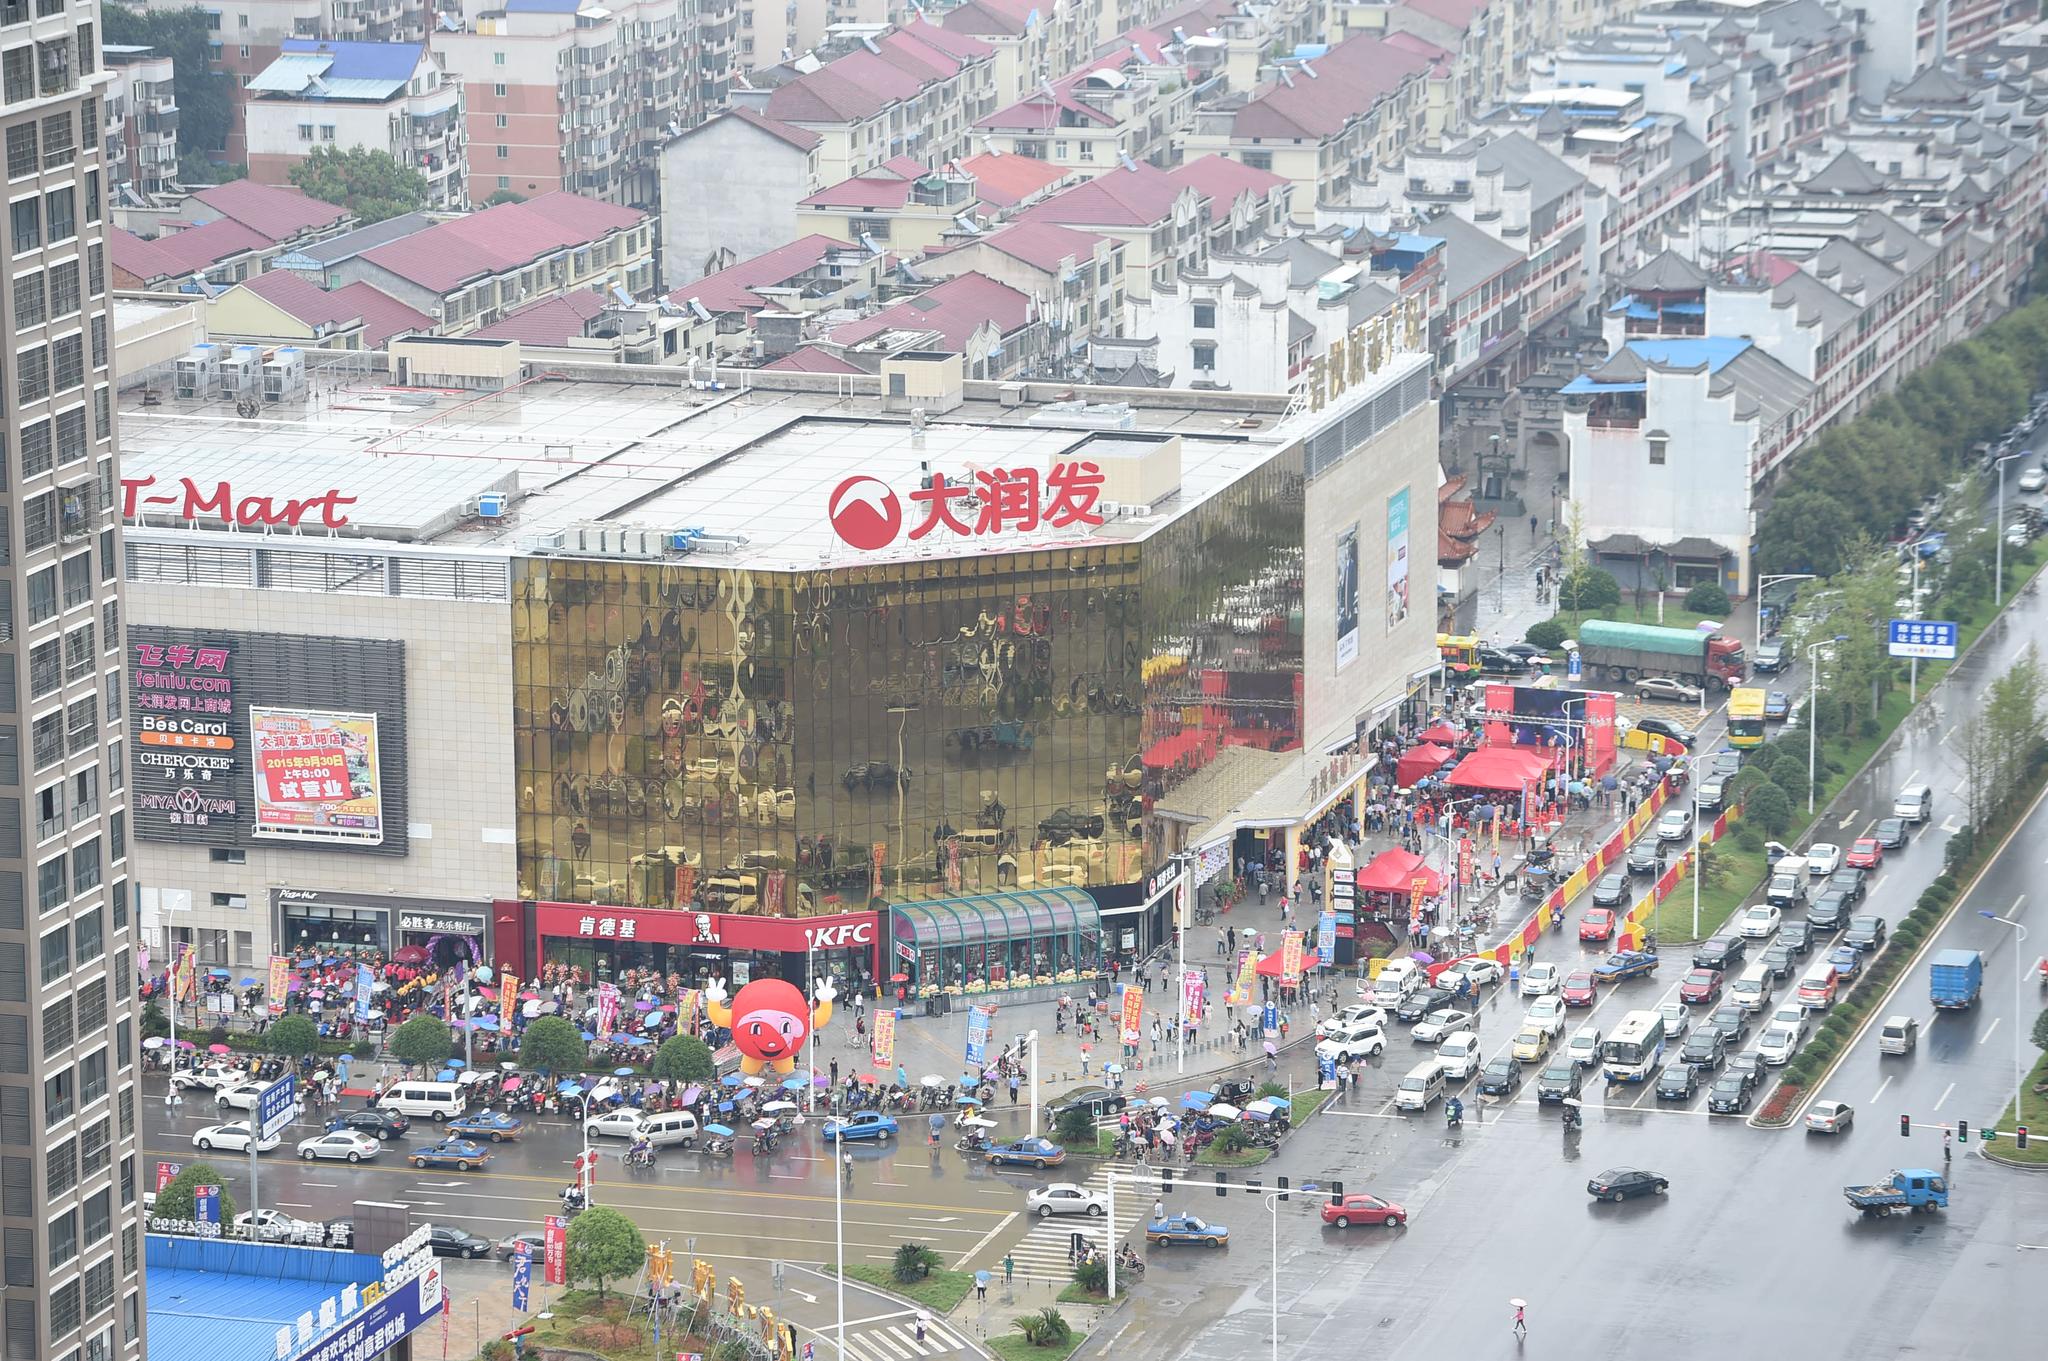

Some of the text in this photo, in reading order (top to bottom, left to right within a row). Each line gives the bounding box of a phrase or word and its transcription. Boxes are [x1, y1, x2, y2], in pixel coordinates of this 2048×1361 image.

[908, 461, 1105, 541] 大润发
[136, 644, 230, 672] 飞牛网
[136, 670, 231, 692] feiniu.com
[138, 693, 232, 713] 大润发网上商城
[180, 719, 227, 735] Carol
[260, 733, 342, 748] 大润发浏阳店
[267, 754, 343, 769] 2015年9月30日
[165, 767, 212, 780] 巧乐奇
[283, 768, 330, 779] 上午8:00
[280, 780, 343, 799] 试营业
[140, 794, 236, 814] MIYA YAMI
[279, 889, 319, 900] Pizza Hut
[401, 916, 435, 930] 必胜客
[579, 916, 636, 938] 肯德基
[813, 923, 872, 948] KFC
[361, 1280, 385, 1308] TEL:
